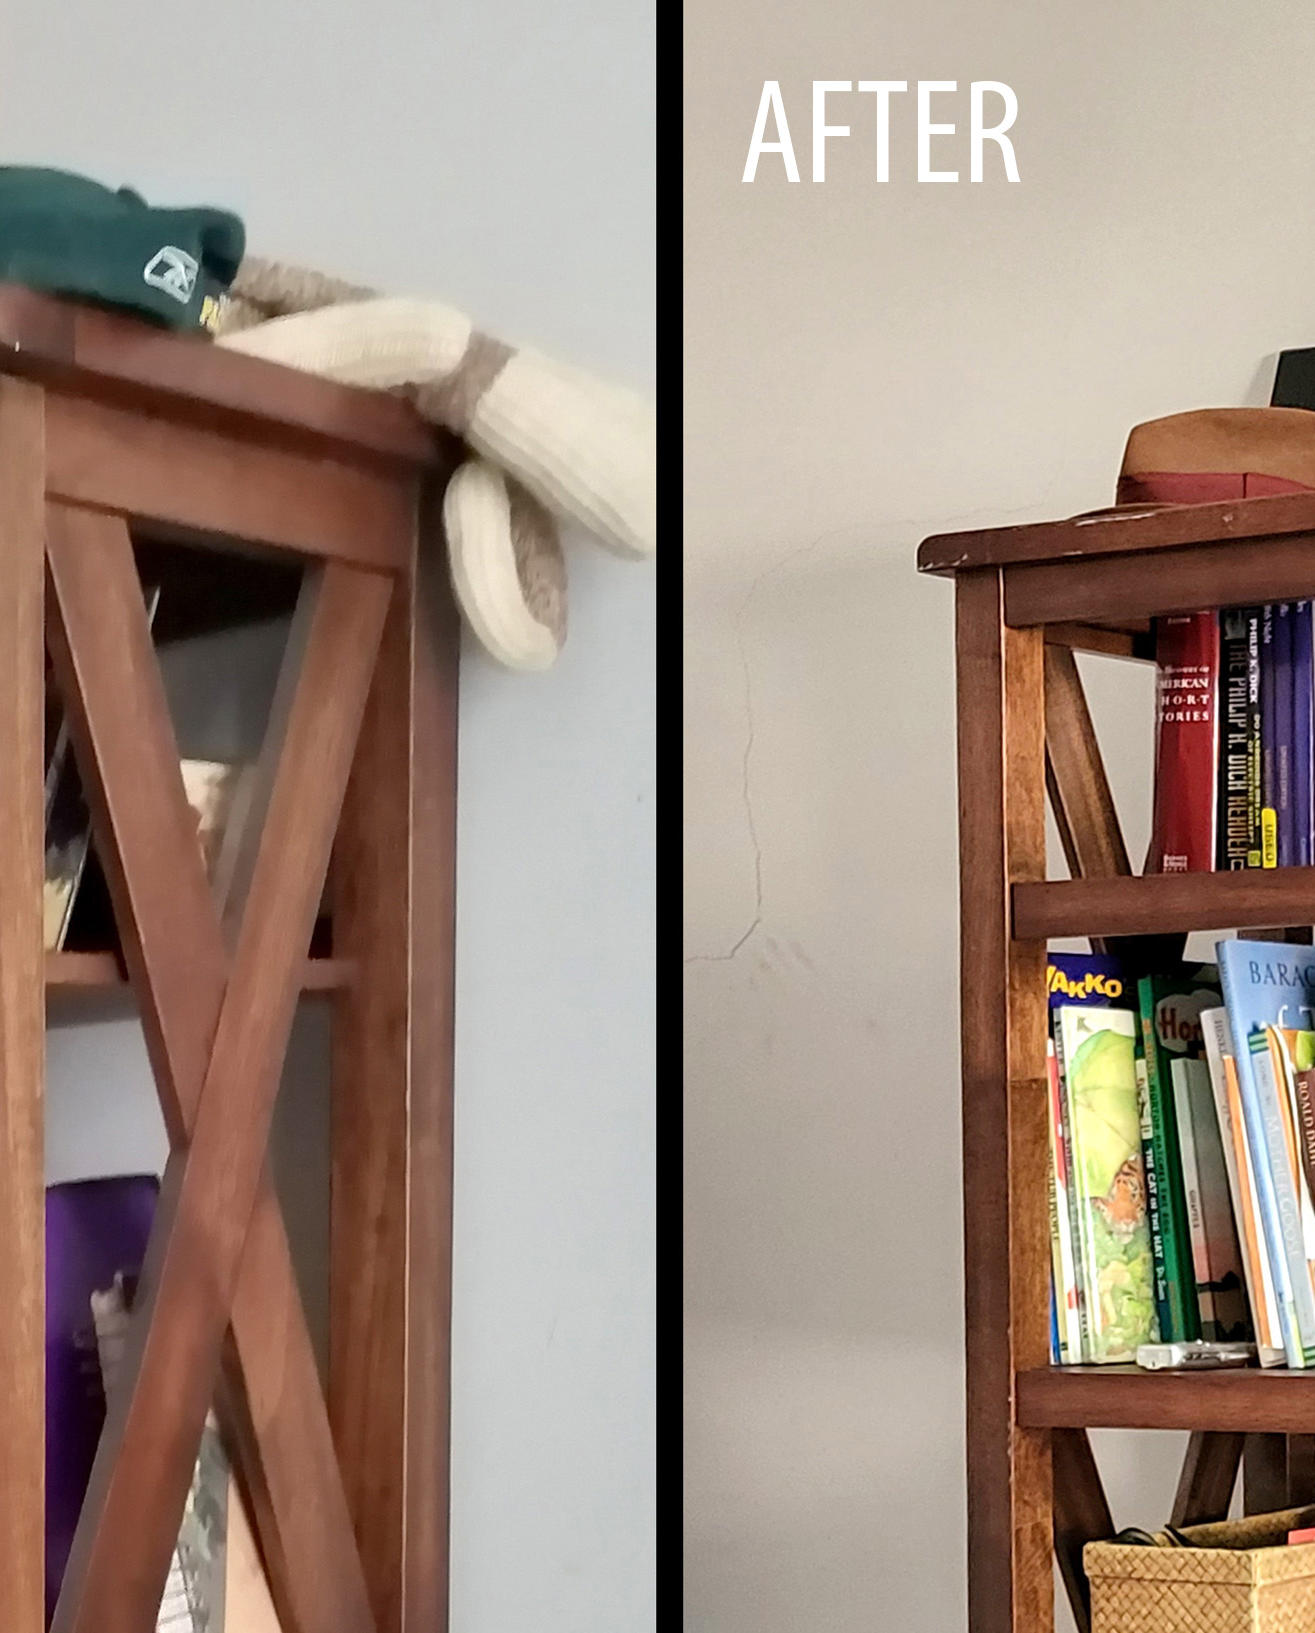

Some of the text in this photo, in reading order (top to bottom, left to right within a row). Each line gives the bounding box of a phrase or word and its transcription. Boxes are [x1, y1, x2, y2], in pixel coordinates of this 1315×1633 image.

[1249, 618, 1258, 703] PHILIP DICK
[1160, 711, 1209, 722] TORIES
[1228, 677, 1247, 728] PHILIP
[1228, 754, 1247, 790] DICK
[1227, 795, 1248, 858] READER
[1264, 824, 1274, 862] USED
[1298, 1080, 1315, 1128] ROALD
[1144, 1147, 1155, 1171] THE
[1265, 1115, 1288, 1194] MOTHER
[1147, 1172, 1158, 1195] CAT
[1150, 1212, 1161, 1232] THE
[1153, 1234, 1164, 1259] HAT
